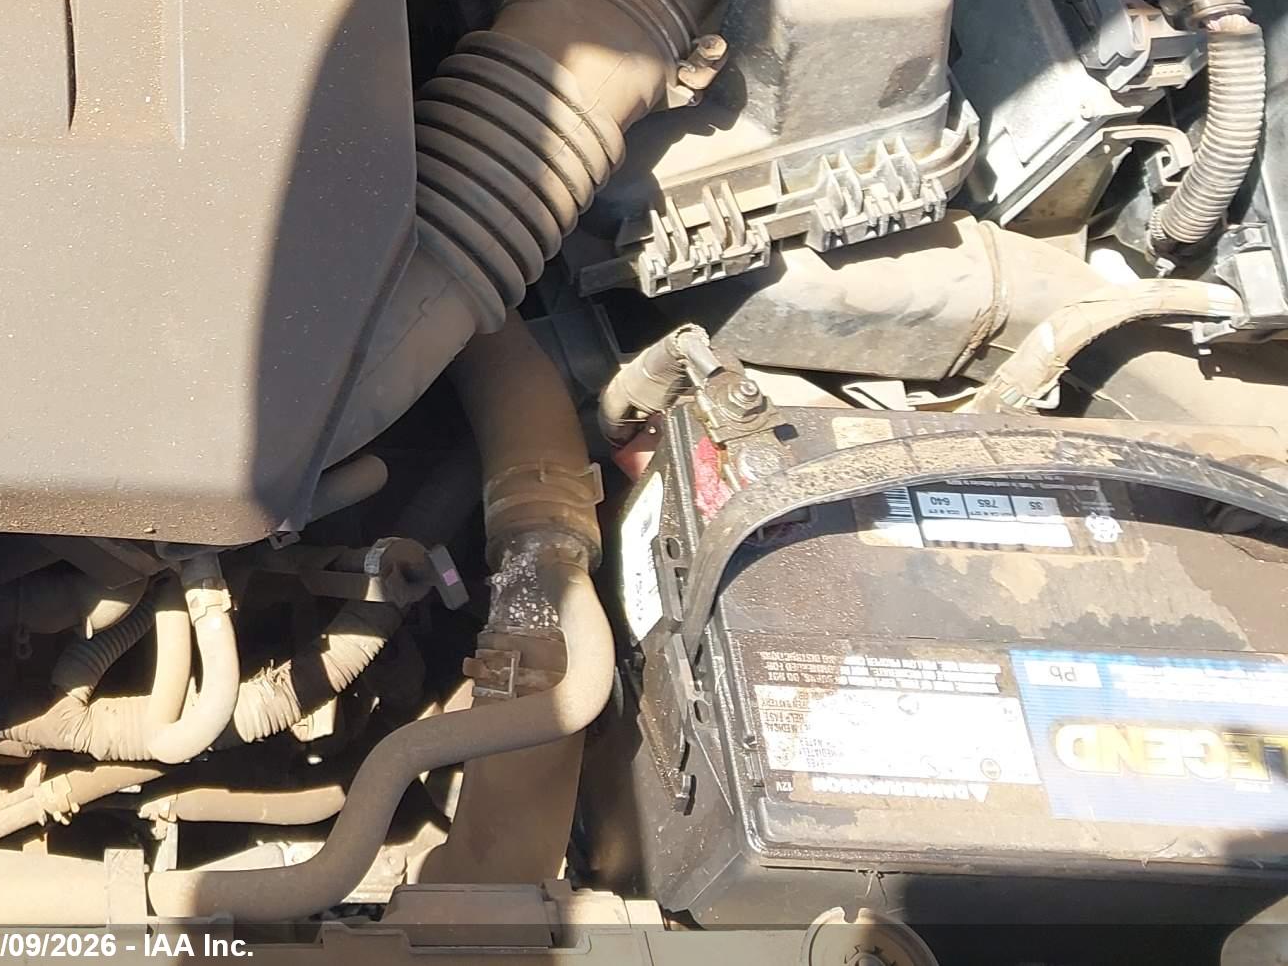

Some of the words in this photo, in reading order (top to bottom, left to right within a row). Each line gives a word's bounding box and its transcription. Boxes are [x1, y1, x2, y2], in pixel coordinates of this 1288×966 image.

[929, 496, 951, 506] 640
[977, 498, 997, 509] 785
[1029, 501, 1043, 511] 35
[1049, 665, 1077, 683] Pb
[775, 780, 794, 792] 12V
